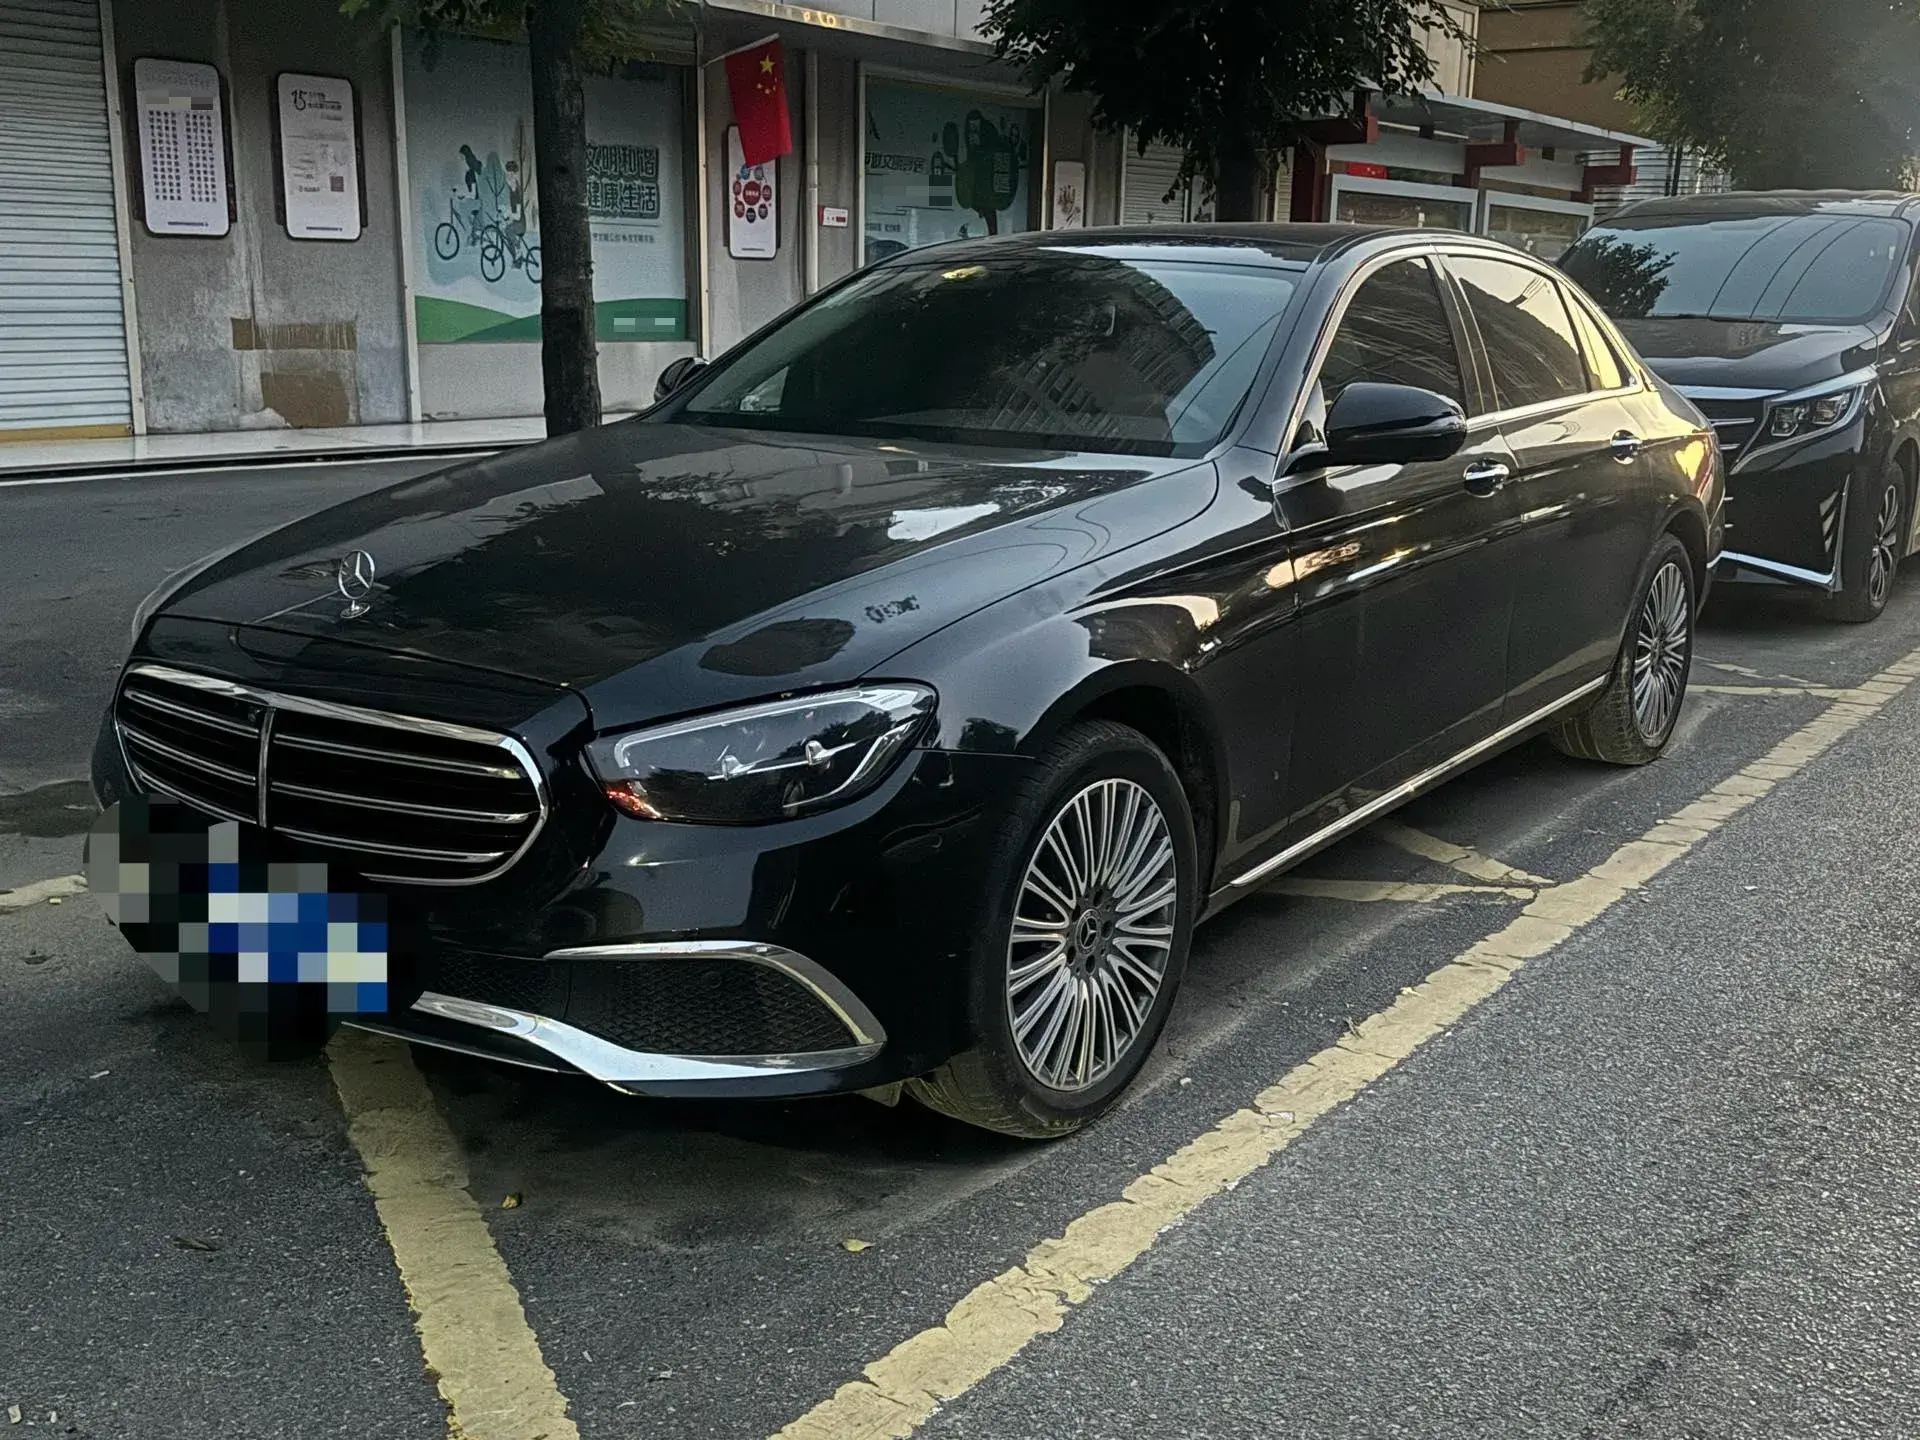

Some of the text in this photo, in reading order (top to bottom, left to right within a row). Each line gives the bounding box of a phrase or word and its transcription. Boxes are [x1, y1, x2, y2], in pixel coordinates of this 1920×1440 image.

[586, 145, 657, 177] 文明和谐
[587, 181, 658, 212] 健康生活
